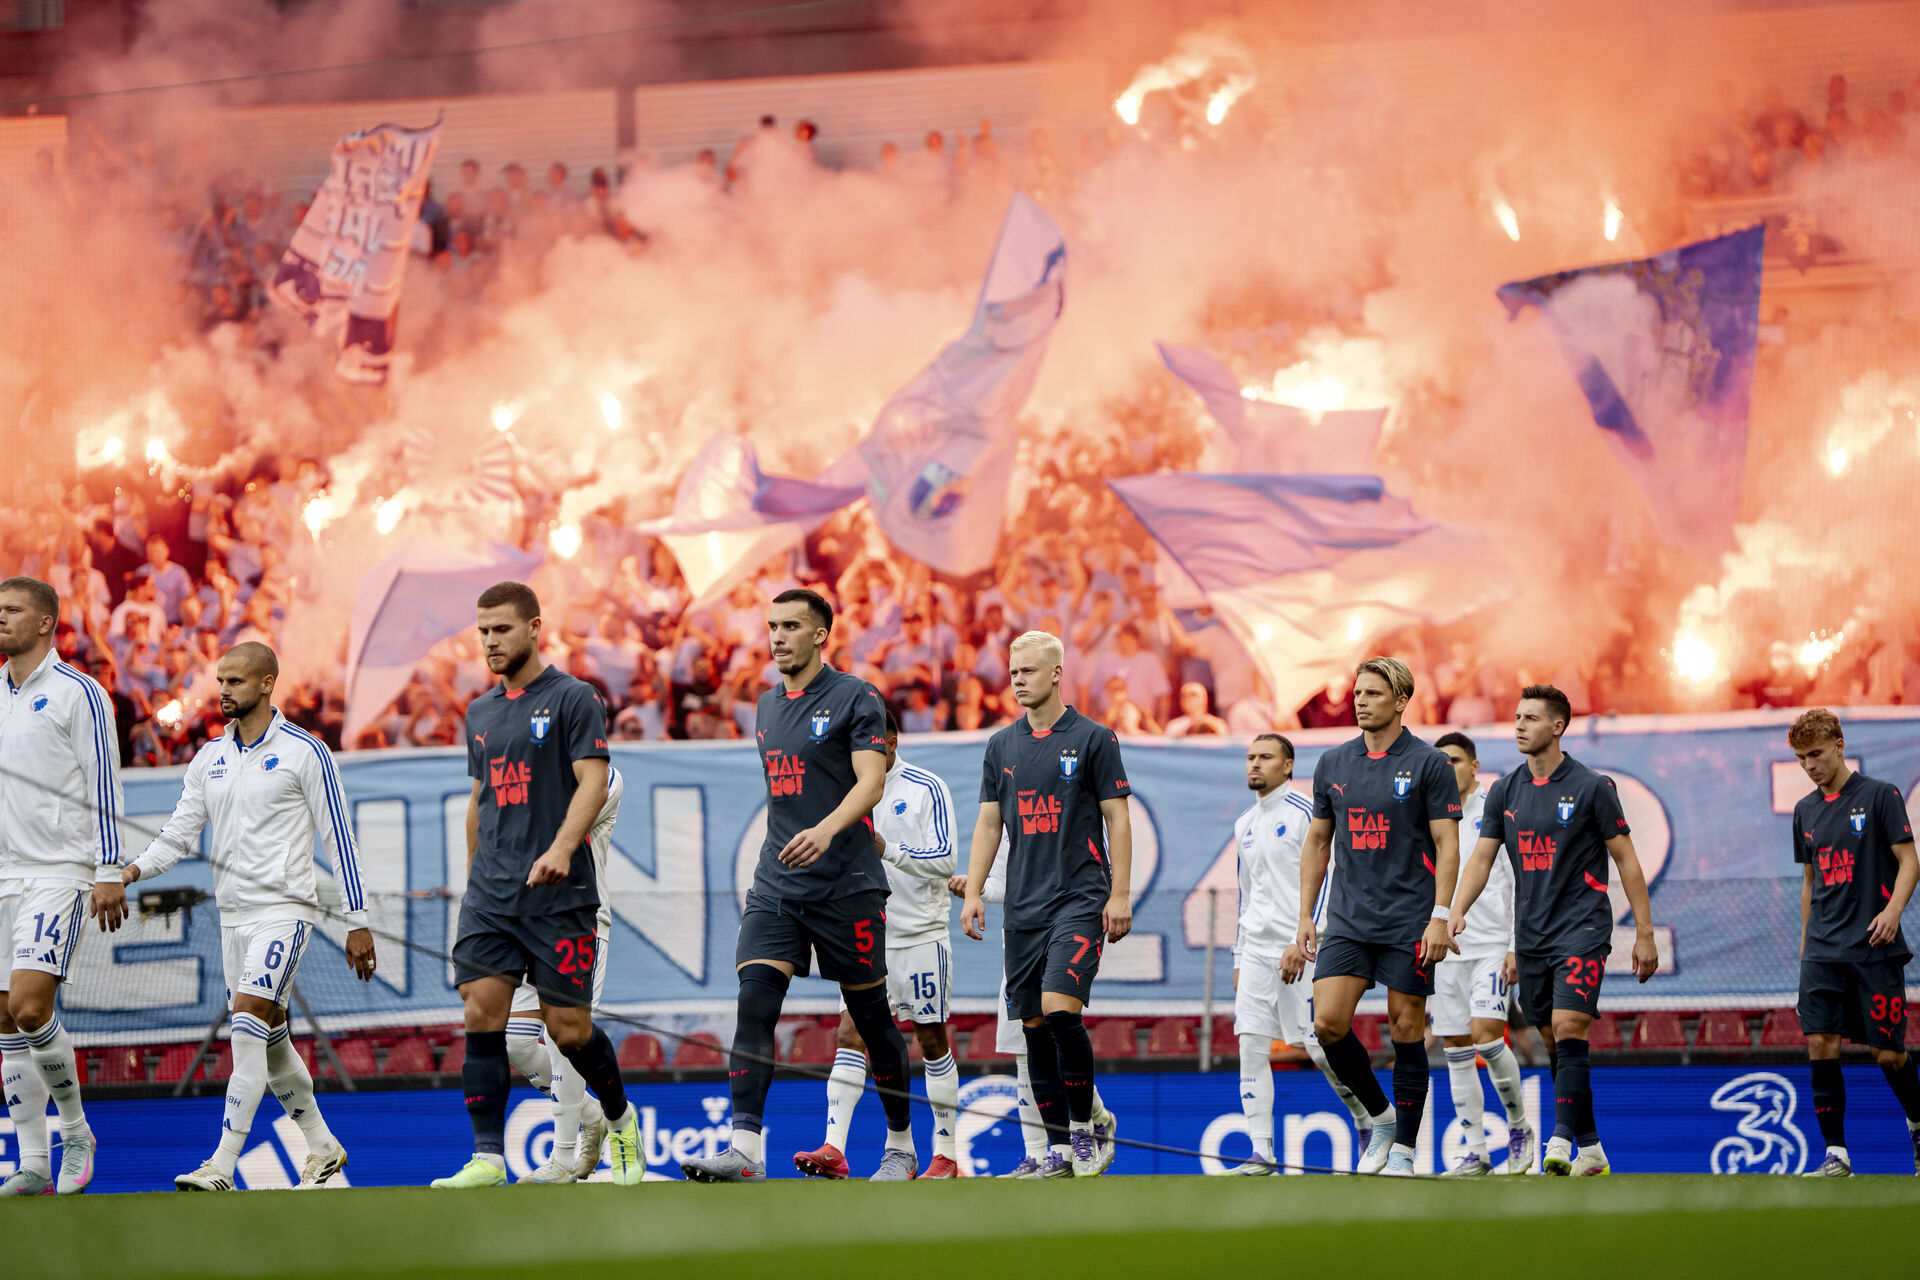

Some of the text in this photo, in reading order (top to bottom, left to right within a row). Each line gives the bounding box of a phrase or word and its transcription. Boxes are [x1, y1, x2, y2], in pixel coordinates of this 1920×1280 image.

[495, 783, 529, 808] MÖ!
[770, 775, 803, 796] MÖ!
[1022, 814, 1059, 835] MÖ!
[1352, 831, 1387, 850] MÖ!
[1522, 853, 1553, 872] MÖ!
[34, 912, 61, 946] 14
[854, 918, 875, 953] 5
[265, 940, 285, 970] 6
[555, 935, 594, 975] 25
[1070, 934, 1090, 964] 7
[910, 971, 937, 1000] 15
[1565, 956, 1600, 987] 23
[1870, 993, 1902, 1024] 38
[42, 1061, 66, 1073] KBH
